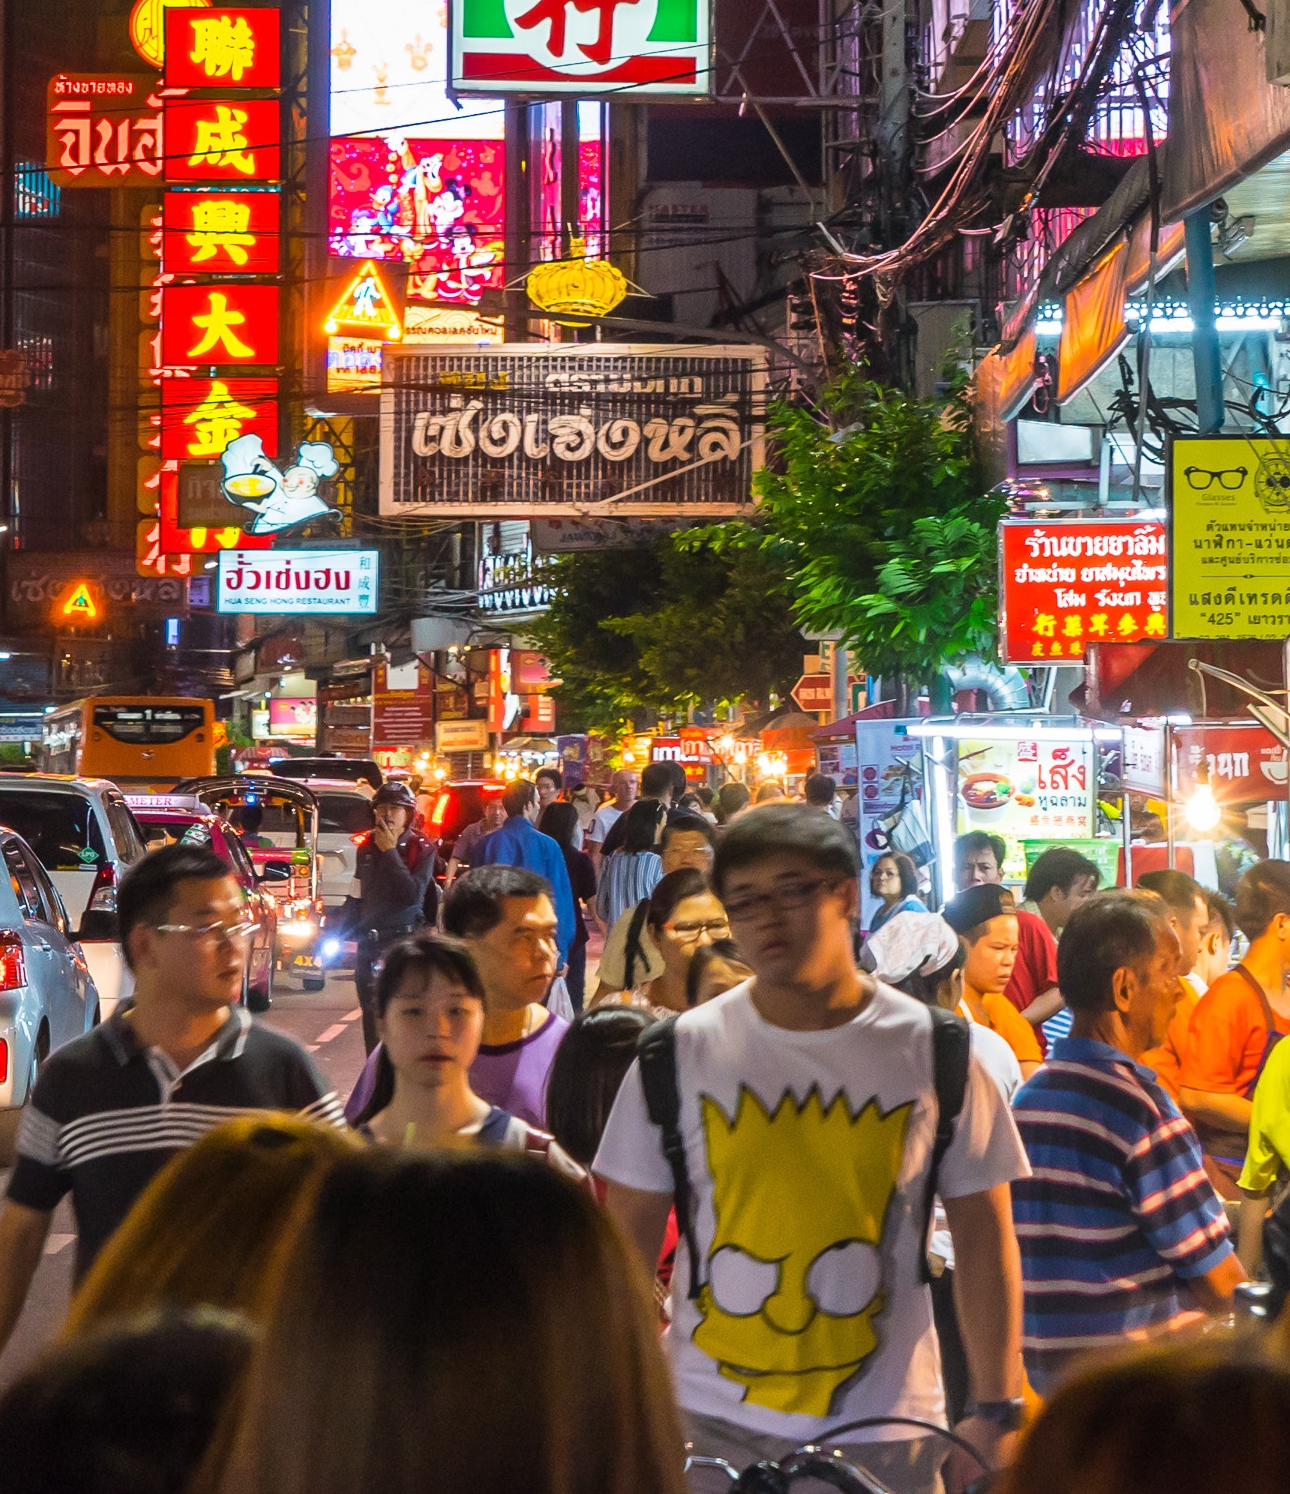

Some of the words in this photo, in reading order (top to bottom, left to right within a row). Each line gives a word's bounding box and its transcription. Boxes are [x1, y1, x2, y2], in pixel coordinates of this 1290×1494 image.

[54, 73, 133, 94] ห้างขายทอง
[1206, 519, 1290, 532] ตัวแทนจำหน่าย
[1014, 562, 1076, 583] จำหน่าย
[224, 597, 243, 605] HUA
[245, 597, 268, 605] SENG
[270, 597, 294, 605] HONG
[296, 597, 352, 605] RESTAURANT
[1054, 588, 1087, 608] โสม
[1094, 588, 1142, 607] รังนก
[1038, 746, 1087, 791] เส็ง
[123, 796, 173, 807] METER
[1038, 794, 1087, 812] หูฉลาม
